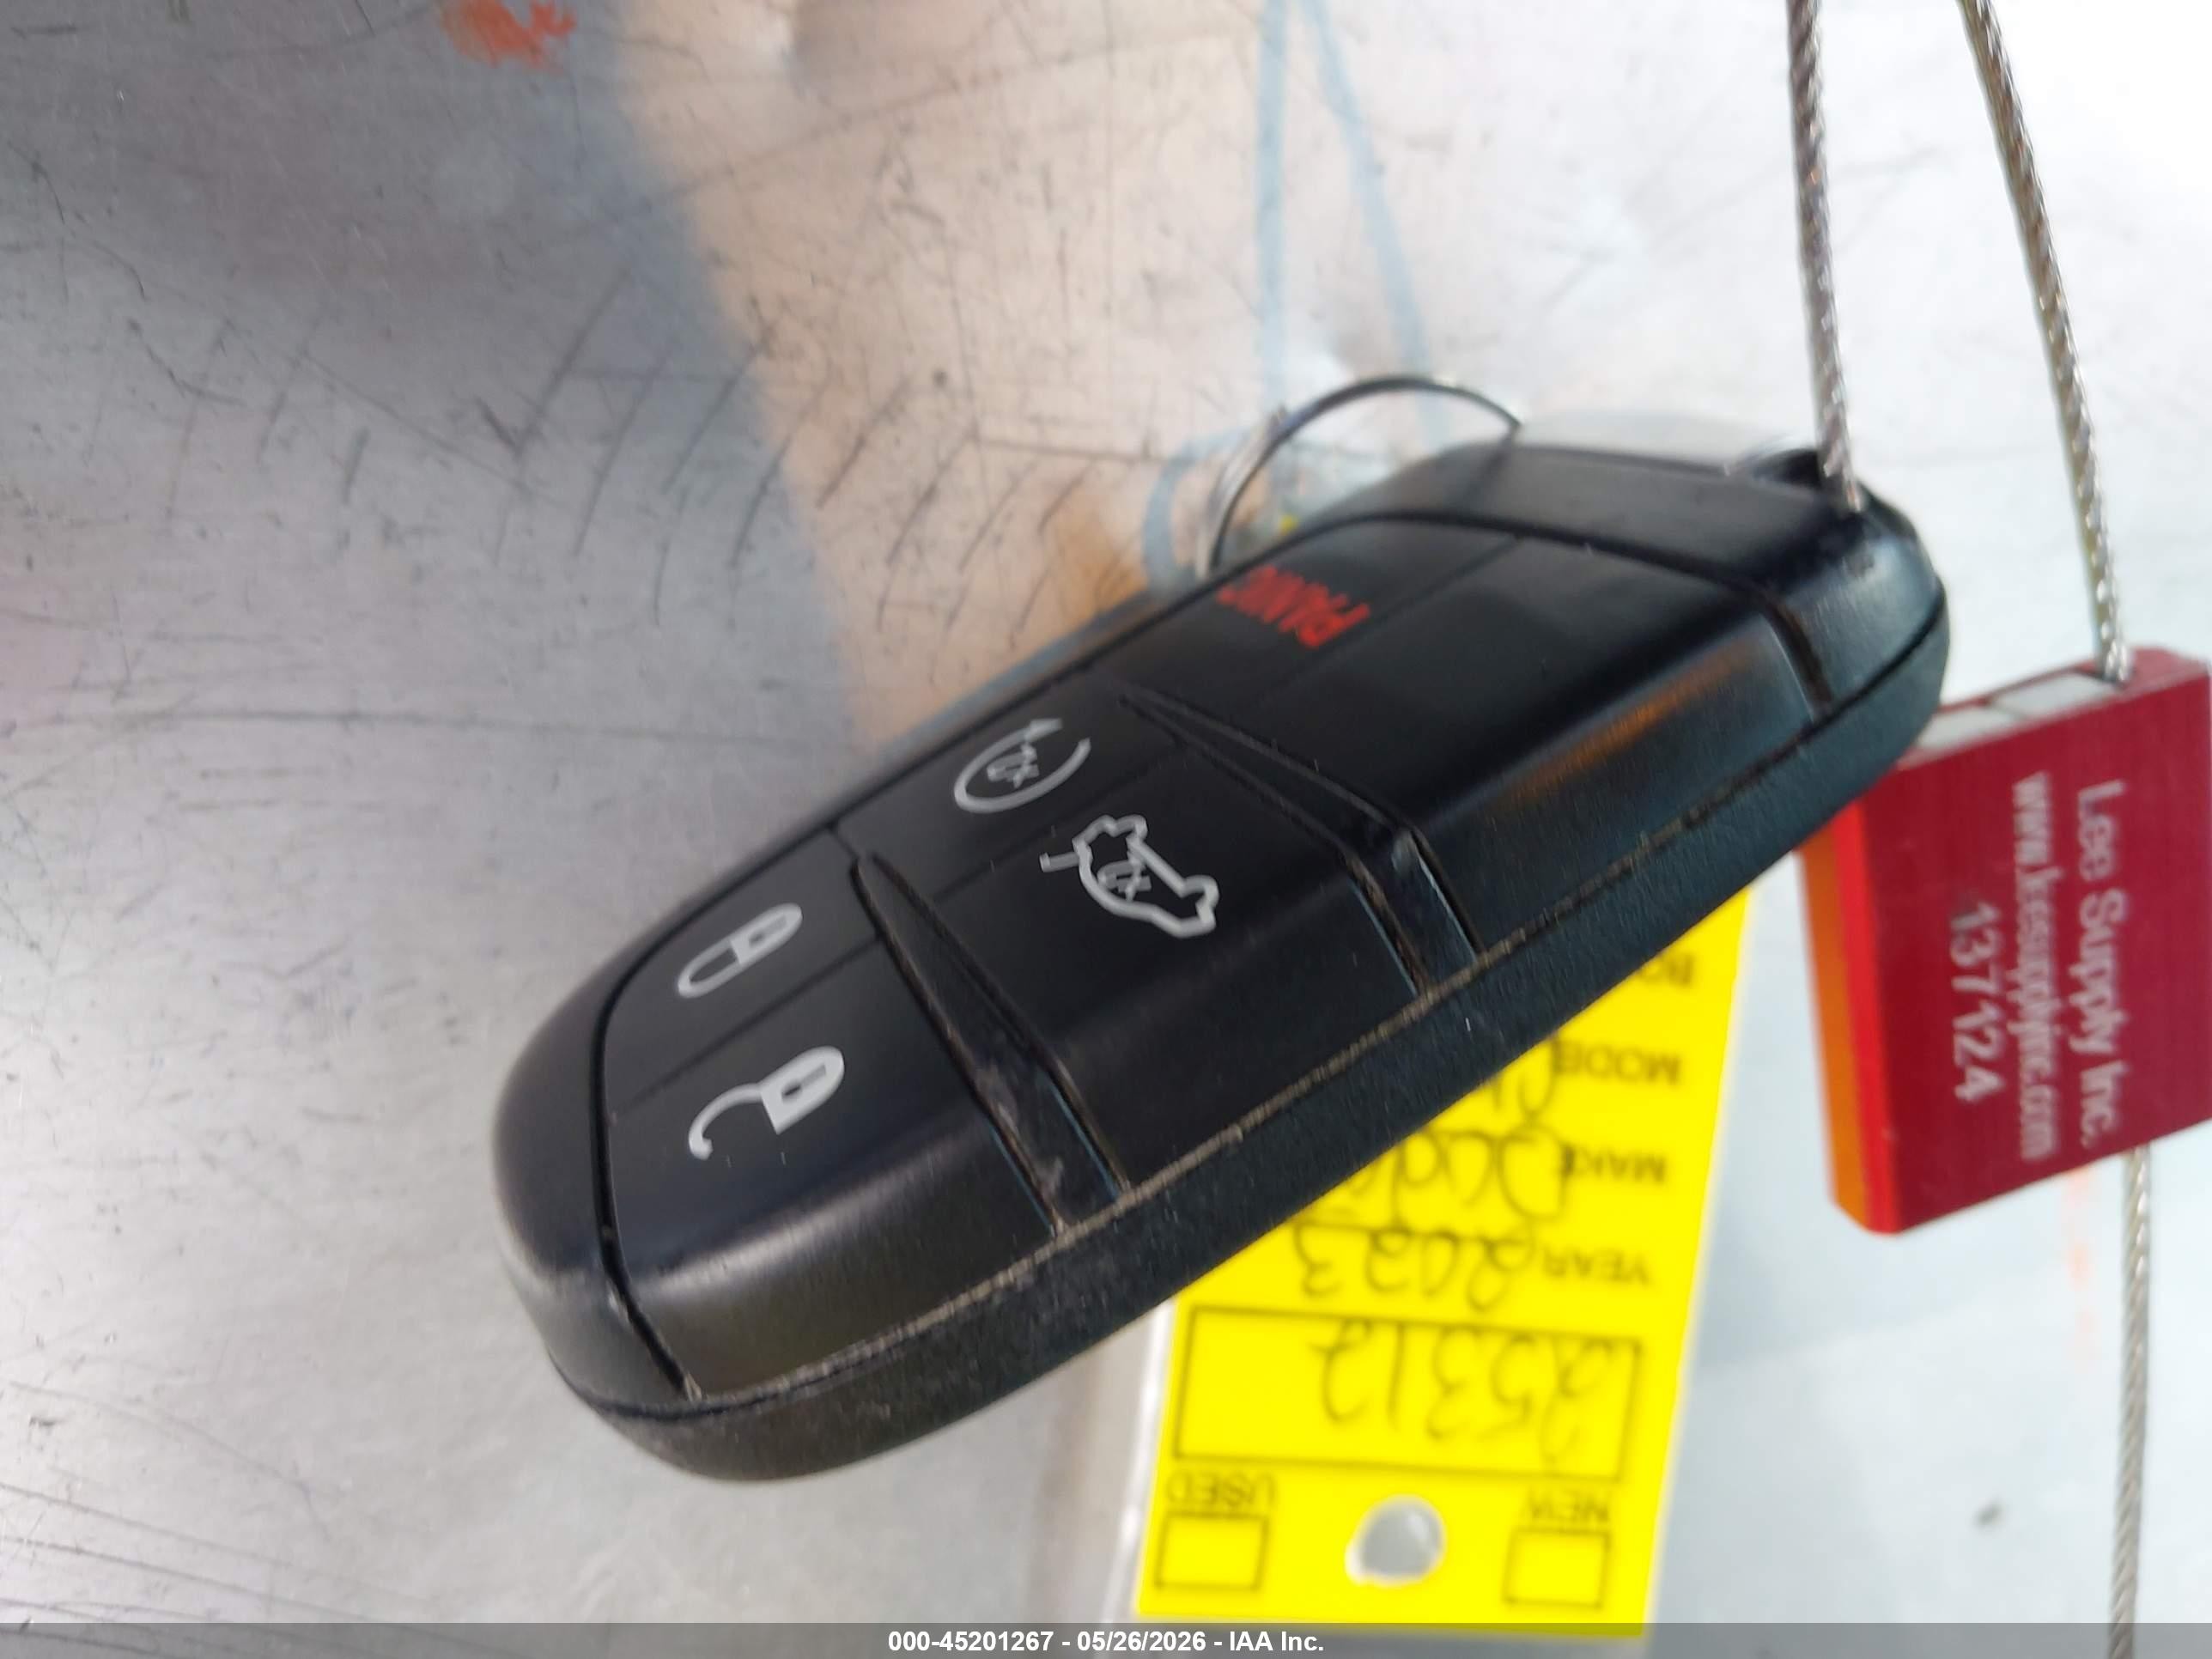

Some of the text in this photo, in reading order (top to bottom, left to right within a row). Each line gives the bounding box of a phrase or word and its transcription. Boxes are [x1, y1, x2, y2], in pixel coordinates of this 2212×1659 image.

[1948, 897, 2006, 1104] 137124
[2068, 780, 2130, 1149] Lee Supply Inc.
[1293, 1220, 1536, 1314] 2023
[1540, 1243, 1652, 1287] YEAR
[1309, 1320, 1620, 1470] 25312
[1166, 1470, 1275, 1509] USED
[1526, 1486, 1611, 1526] NEW
